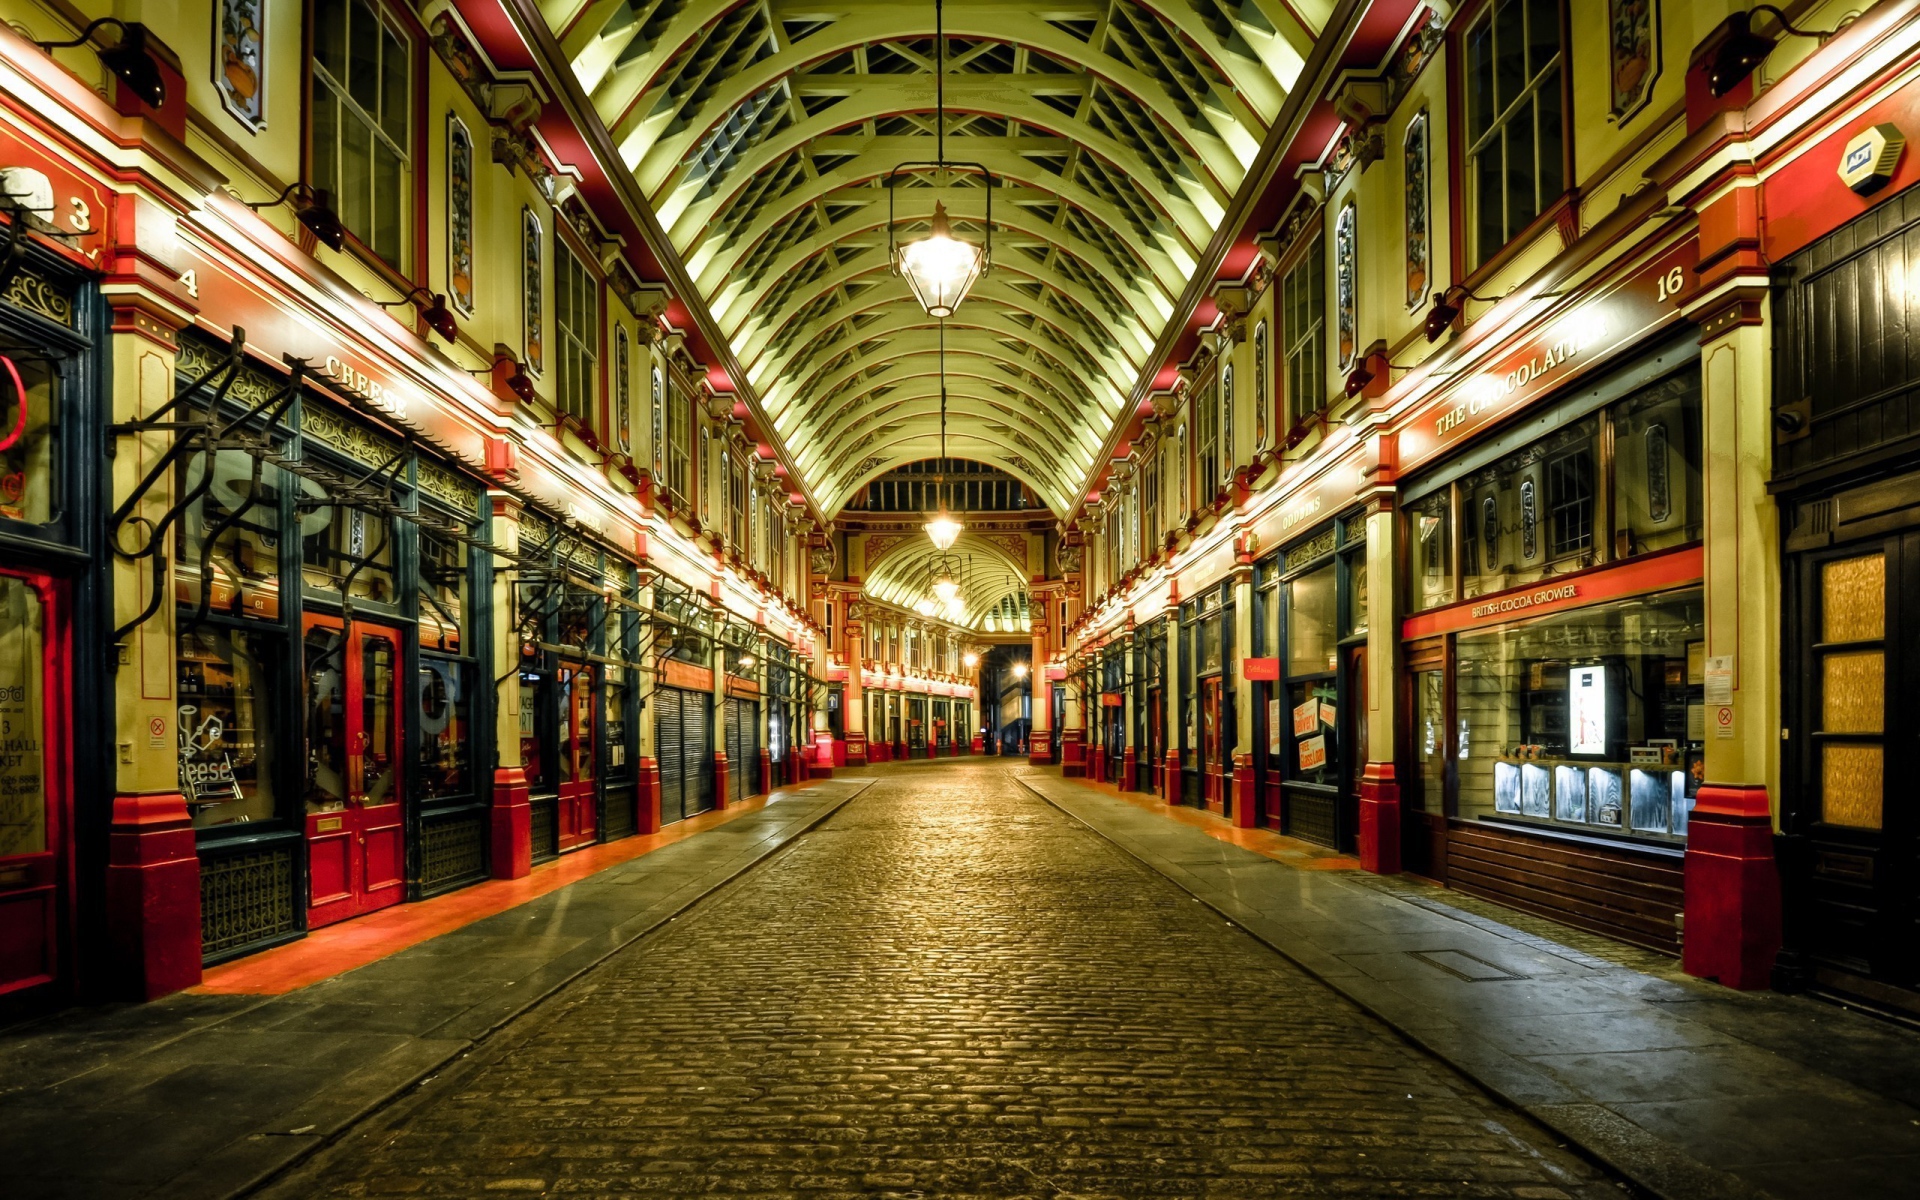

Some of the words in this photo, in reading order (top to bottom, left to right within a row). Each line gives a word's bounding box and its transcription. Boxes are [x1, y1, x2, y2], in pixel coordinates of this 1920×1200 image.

[69, 197, 91, 231] 3
[179, 269, 198, 298] 4
[1658, 266, 1684, 302] 16
[325, 355, 408, 420] CHEESE
[1435, 404, 1467, 436] THE
[1471, 602, 1499, 619] BRITISH
[1500, 596, 1533, 613] COCOA
[1534, 584, 1576, 606] GROWER
[2, 720, 11, 735] 3
